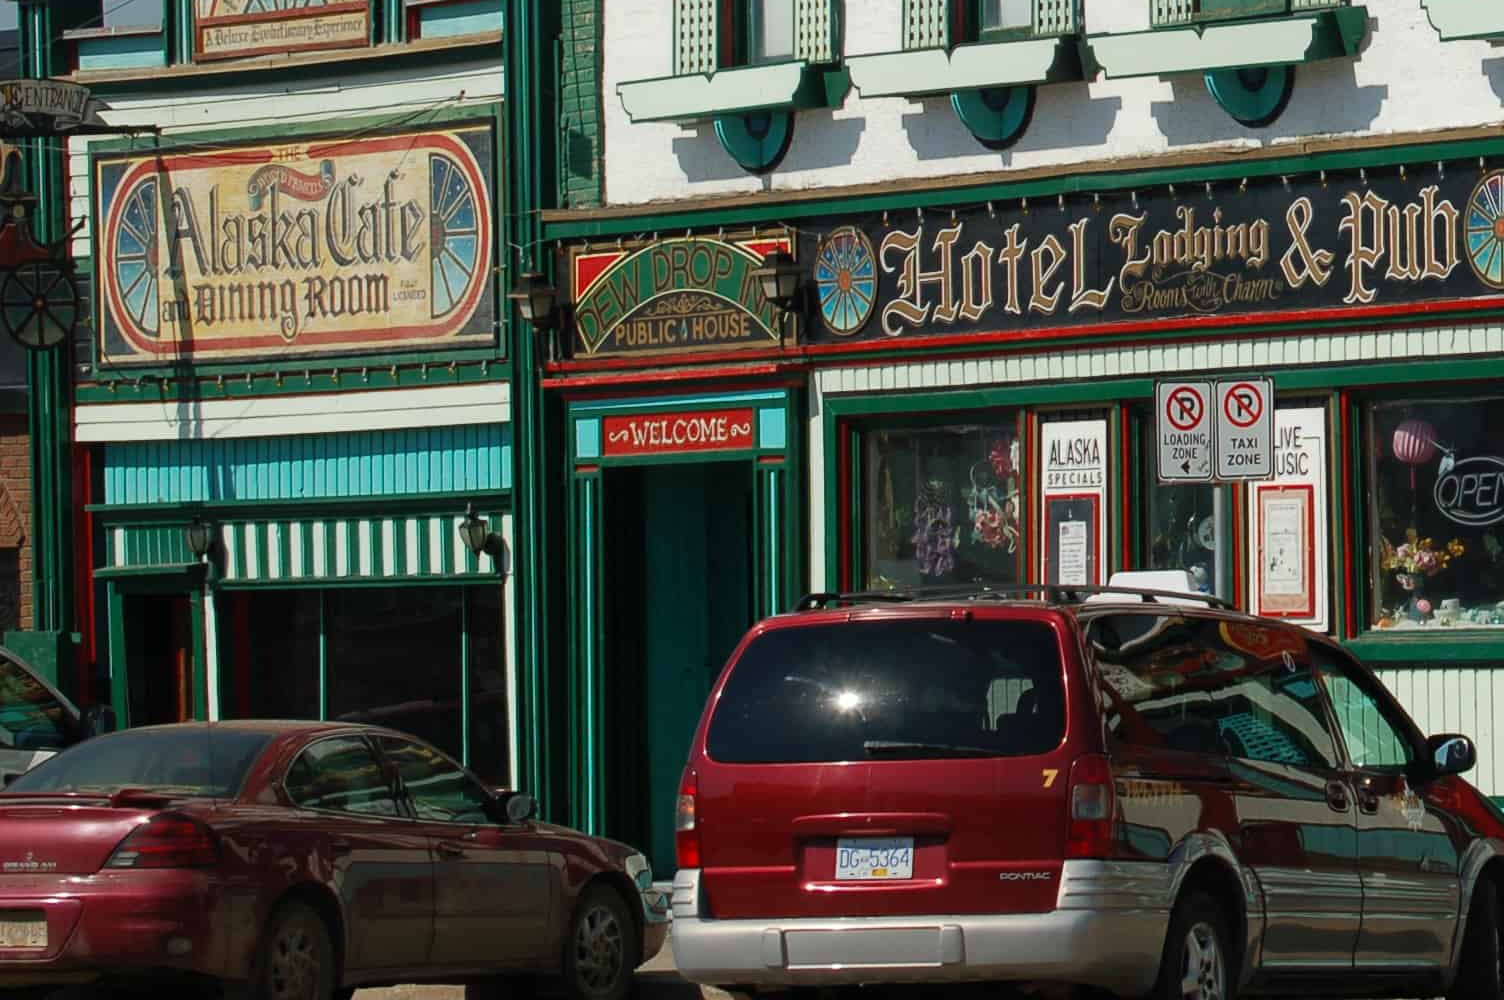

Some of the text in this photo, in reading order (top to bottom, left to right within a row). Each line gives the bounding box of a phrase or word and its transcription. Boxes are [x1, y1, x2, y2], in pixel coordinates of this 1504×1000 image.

[164, 183, 321, 277] Alaska
[1109, 205, 1271, 296] Lodging
[1280, 196, 1335, 289] &
[1341, 184, 1460, 304] Pub
[194, 278, 299, 341] Dining
[301, 271, 391, 320] Room
[576, 257, 641, 346] DEW
[652, 245, 733, 293] DROP
[1121, 281, 1189, 313] Rooms
[615, 311, 751, 346] PUBLIC HOUSE
[629, 416, 728, 447] WELCOME
[1163, 433, 1206, 447] LOADING
[1230, 437, 1259, 450] TAXI
[1275, 426, 1304, 450] IVE
[1050, 436, 1101, 467] ALASKA
[1171, 447, 1199, 460] ZONE
[1226, 453, 1262, 467] ZONE
[1275, 452, 1310, 476] USIC
[1047, 471, 1104, 487] SPECIALS
[1042, 768, 1059, 788] 7
[999, 871, 1052, 881] PONTIAC
